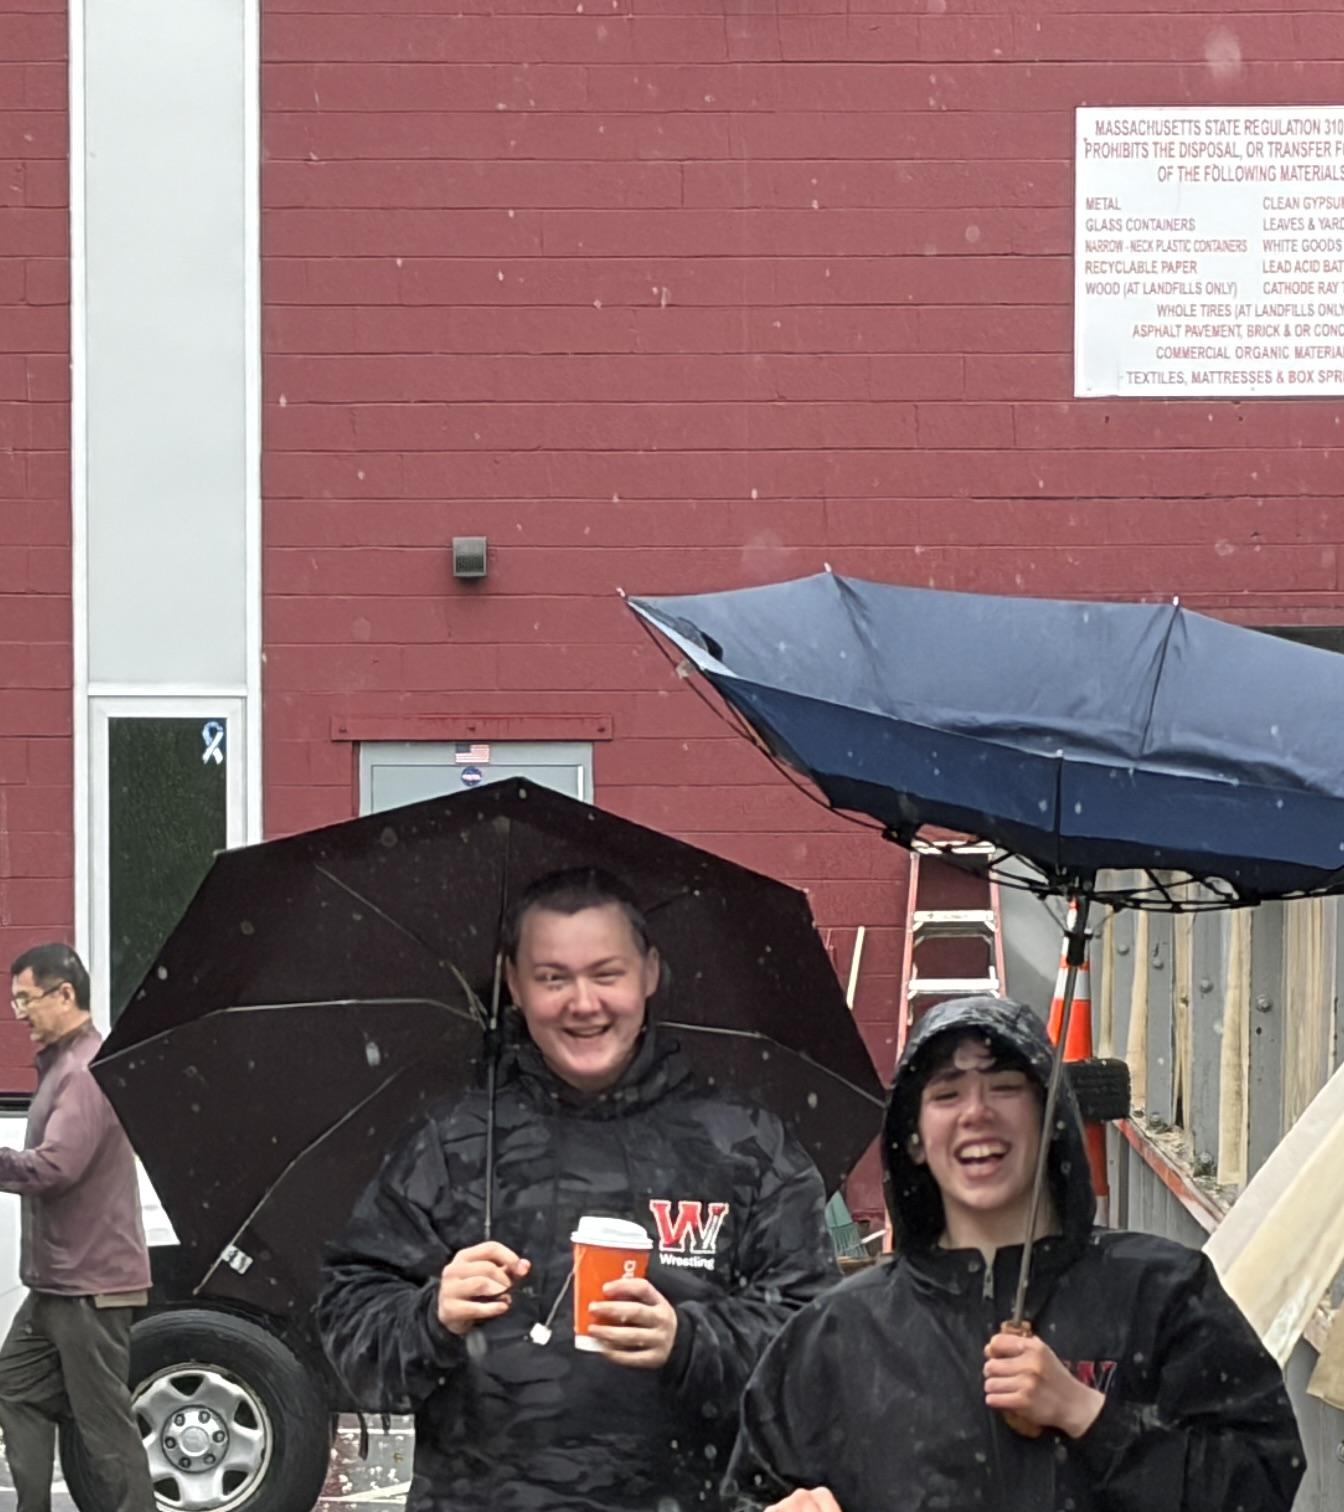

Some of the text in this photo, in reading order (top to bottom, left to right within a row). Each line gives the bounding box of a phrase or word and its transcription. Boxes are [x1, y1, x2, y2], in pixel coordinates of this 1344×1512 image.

[1095, 120, 1201, 135] MASSACHUSETTS
[1205, 120, 1240, 135] STATE
[1244, 119, 1320, 135] REGULATION
[1325, 119, 1344, 135] 310
[1085, 142, 1148, 159] PROHIBITS
[1152, 142, 1175, 158] THE
[1179, 142, 1243, 160] DISPOSAL,
[1246, 141, 1264, 158] OR
[1268, 141, 1331, 158] TRANSFER
[1158, 166, 1174, 182] OF
[1178, 166, 1200, 182] THE
[1204, 165, 1276, 182] FOLLOWING
[1086, 197, 1120, 210] METAL
[1263, 197, 1299, 209] CLEAN
[1085, 218, 1195, 232] GLASS CONTAINERS
[1263, 218, 1304, 231] LEAVES
[1308, 218, 1315, 231] &
[1085, 240, 1123, 252] NARROW
[1156, 240, 1191, 252] PLASTIC
[1194, 239, 1247, 252] CONTAINERS
[1263, 239, 1342, 252] WHITE GOODS
[1085, 261, 1198, 274] RECYCLABLE PAPER
[1263, 260, 1291, 273] LEAD
[1295, 260, 1320, 273] ACID
[1086, 282, 1237, 298] WOOD (AT LANDFILLS ONLY)
[1263, 282, 1314, 295] CATHODE
[1318, 282, 1339, 294] RAY
[1157, 304, 1197, 317] WHOLE
[1201, 304, 1231, 317] TIRES
[1235, 304, 1251, 319] (AT
[1255, 304, 1314, 317] LANDFILLS
[1133, 325, 1182, 337] ASPHALT
[1185, 325, 1243, 339] PAVEMENT,
[1247, 324, 1280, 337] BRICK
[1284, 324, 1291, 337] &
[1295, 324, 1310, 336] OR
[1156, 347, 1230, 359] COMMERCIAL
[1235, 347, 1289, 359] ORGANIC
[1127, 372, 1188, 386] TEXTILES,
[1191, 371, 1272, 384] MATTRESSES
[1276, 371, 1284, 383] &
[1288, 371, 1314, 383] BOX
[649, 1200, 729, 1254] W
[659, 1253, 715, 1271] Wrestling
